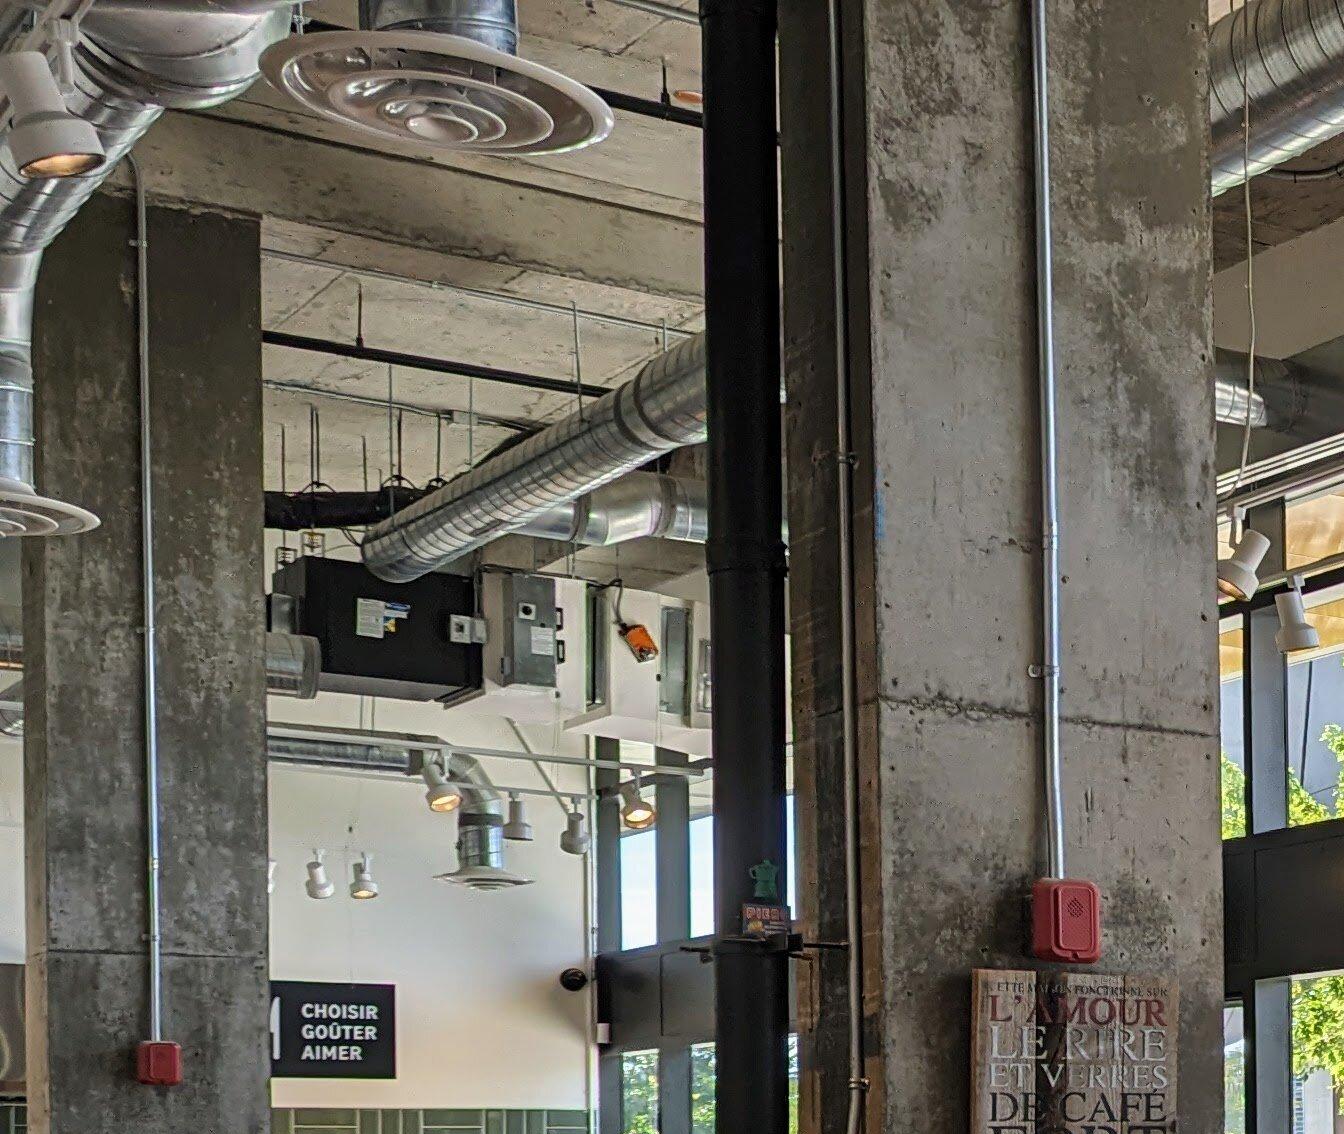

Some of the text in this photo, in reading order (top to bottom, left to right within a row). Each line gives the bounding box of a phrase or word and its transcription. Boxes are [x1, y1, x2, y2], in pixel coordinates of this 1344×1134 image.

[301, 1003, 379, 1020] CHOISIR
[301, 1022, 378, 1041] GOÛTER
[301, 1045, 362, 1061] AIMER
[989, 1025, 1167, 1062] LE RIRE
[988, 1063, 1168, 1089] ET VERRES
[989, 1088, 1167, 1123] DE CAFÉ
